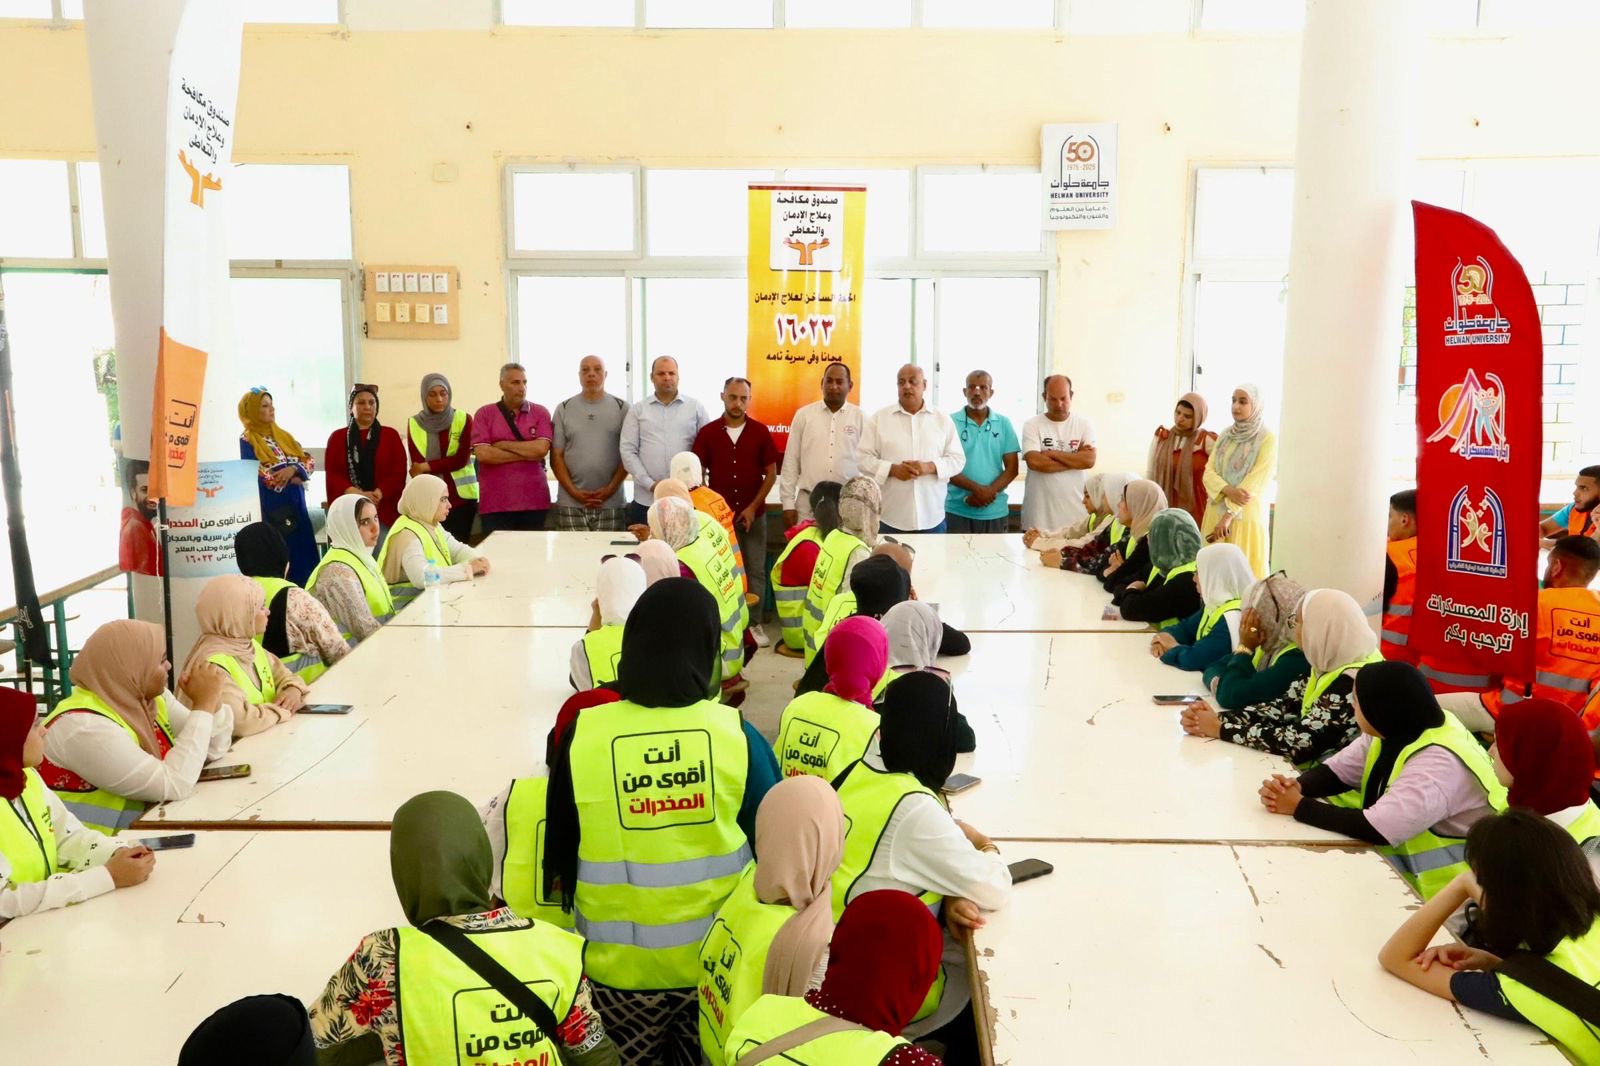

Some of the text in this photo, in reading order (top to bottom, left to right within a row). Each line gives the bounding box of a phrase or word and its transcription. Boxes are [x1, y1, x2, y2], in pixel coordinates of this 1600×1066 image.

[182, 77, 230, 127] صندوق مكافحة
[183, 106, 224, 148] وعلاج الإدمان
[1066, 141, 1095, 162] 50
[1050, 174, 1081, 190] حلوان
[777, 192, 838, 207] صندوق مكافحة
[783, 211, 831, 223] وعلاج الإدمان
[755, 293, 779, 305] الإدمان
[781, 293, 803, 304] لعلاج
[805, 293, 835, 304] الساخن
[777, 317, 833, 341] ١٦٠٢٣
[1445, 333, 1511, 345] HELWAN UNIVERSITY
[785, 350, 805, 364] سرية
[766, 423, 790, 433] w.dru
[200, 518, 215, 528] من
[216, 513, 236, 527] أقوى
[236, 511, 252, 523] أنت
[1427, 594, 1496, 623] المعسكرات
[1445, 623, 1513, 653] ترحب بكم
[1557, 626, 1573, 637] من
[644, 739, 680, 764] أنت
[785, 745, 800, 760] من
[622, 760, 706, 793] أقوى من
[629, 793, 705, 816] المخدرات
[465, 1034, 500, 1057] من
